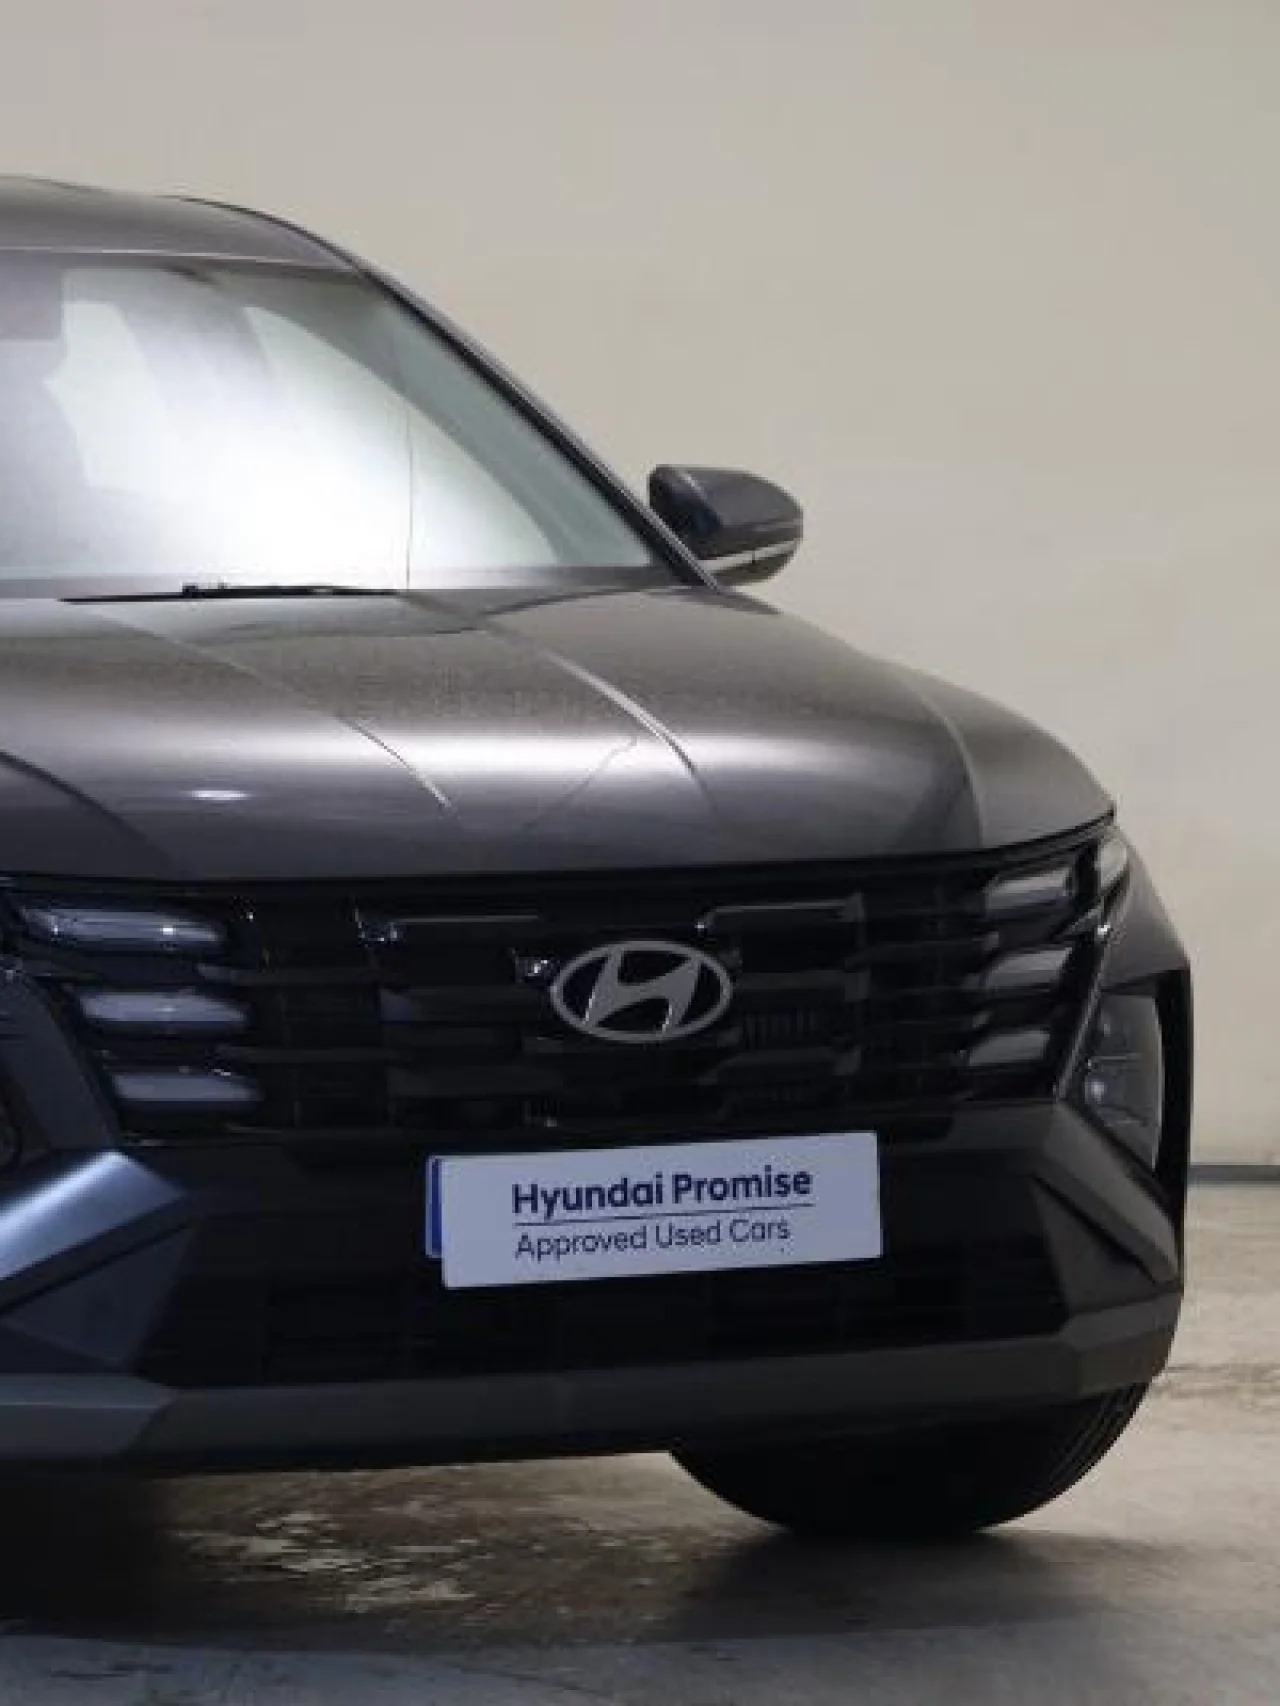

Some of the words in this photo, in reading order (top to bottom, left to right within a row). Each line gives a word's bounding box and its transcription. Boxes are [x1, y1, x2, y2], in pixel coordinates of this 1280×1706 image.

[512, 1172, 664, 1220] Hyundai
[673, 1165, 814, 1204] Promise
[515, 1225, 647, 1263] Approved
[655, 1216, 721, 1249] Used
[728, 1217, 792, 1244] Cars
